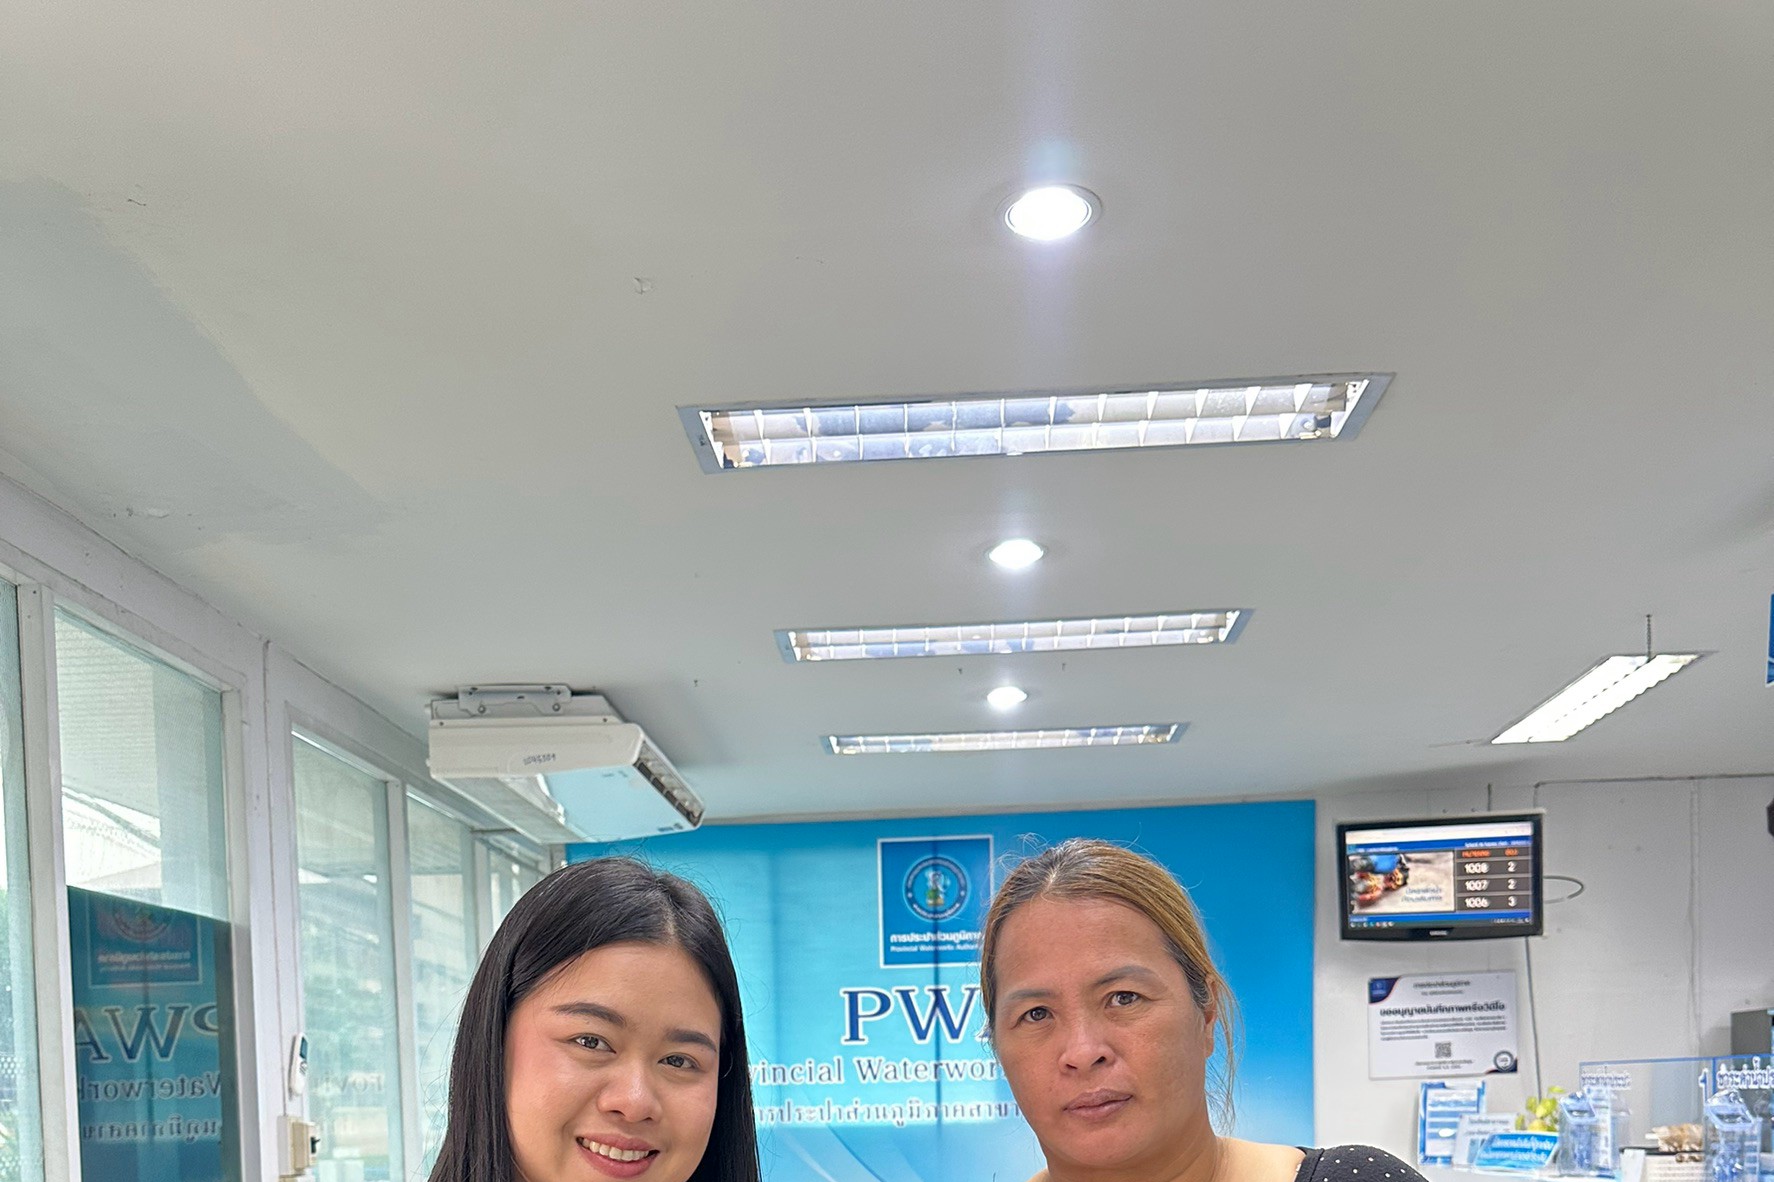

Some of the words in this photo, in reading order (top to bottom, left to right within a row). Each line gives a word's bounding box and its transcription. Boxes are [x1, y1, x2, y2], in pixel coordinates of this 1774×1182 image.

[1507, 861, 1517, 873] 2
[1465, 879, 1489, 891] 1007
[1507, 878, 1517, 890] 2
[1508, 896, 1517, 907] 3
[841, 987, 990, 1043] PW
[856, 1058, 1006, 1082] Waterwor
